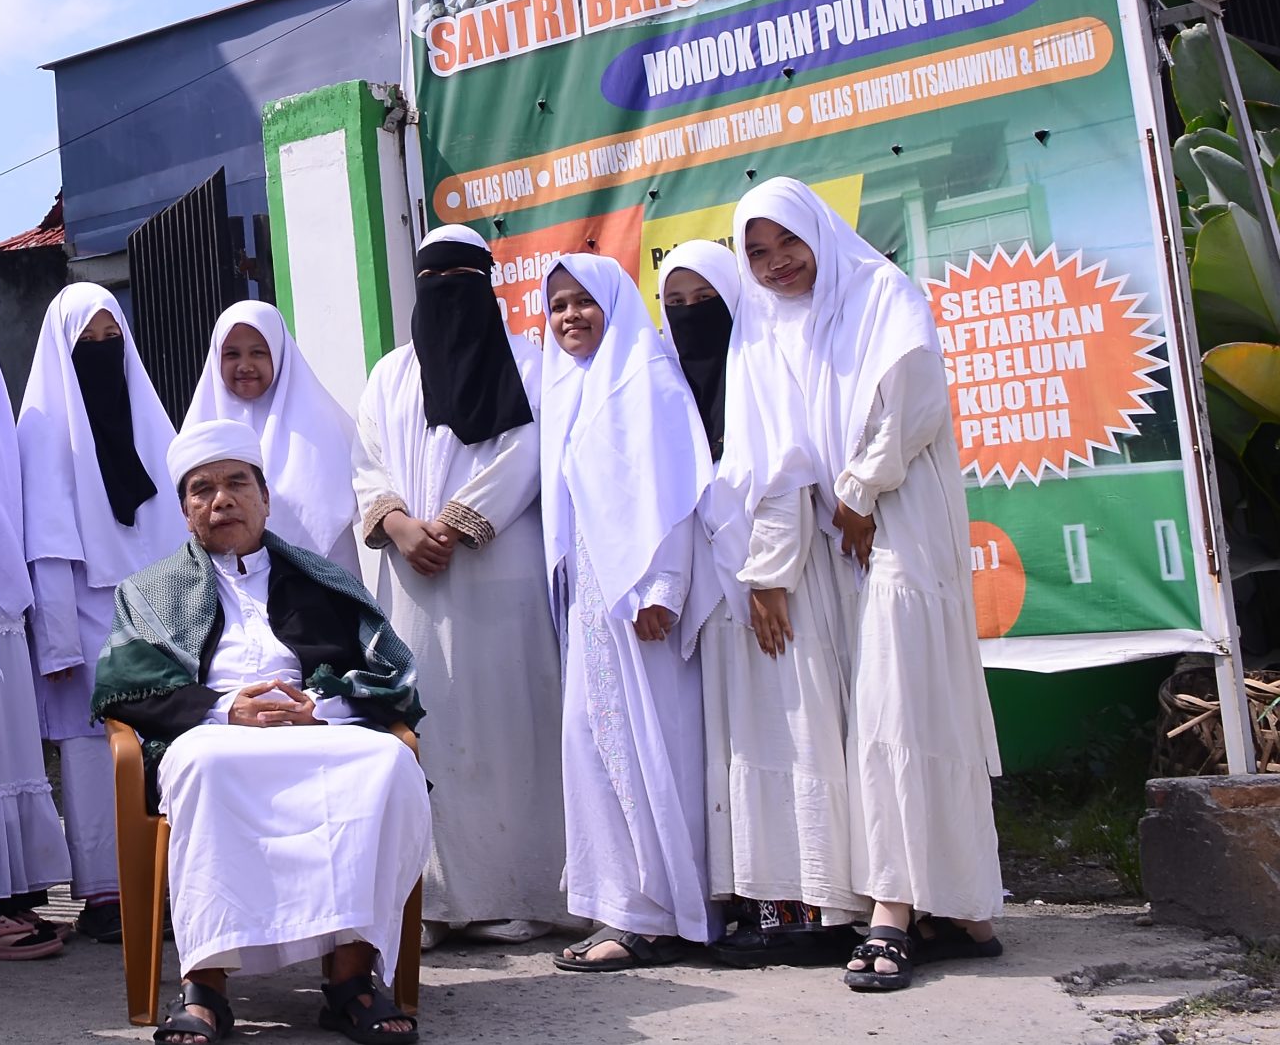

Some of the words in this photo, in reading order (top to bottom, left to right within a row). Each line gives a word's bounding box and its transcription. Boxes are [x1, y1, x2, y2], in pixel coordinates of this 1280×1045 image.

[643, 25, 757, 97] MONDOK
[757, 10, 814, 67] DAN
[463, 174, 502, 209] KELAS
[502, 167, 534, 201] IQRA
[553, 151, 589, 187] KELAS
[590, 138, 643, 178] KHUSUS
[642, 126, 686, 166] UNTUK
[685, 116, 730, 155] TIMUR
[729, 103, 783, 144] TENGAH
[809, 85, 854, 125] KELAS
[852, 72, 914, 110] TAHFIDZ
[913, 45, 1018, 99] (TSANAWIYAH
[1019, 46, 1033, 75] &
[1032, 29, 1096, 72] ALIYAH)
[939, 275, 1068, 322] SEGERA
[935, 303, 1105, 355] AFTARKAN
[943, 339, 1087, 387] SEBELUM
[956, 375, 1070, 417] KUOTA
[959, 408, 1072, 449] PENUH
